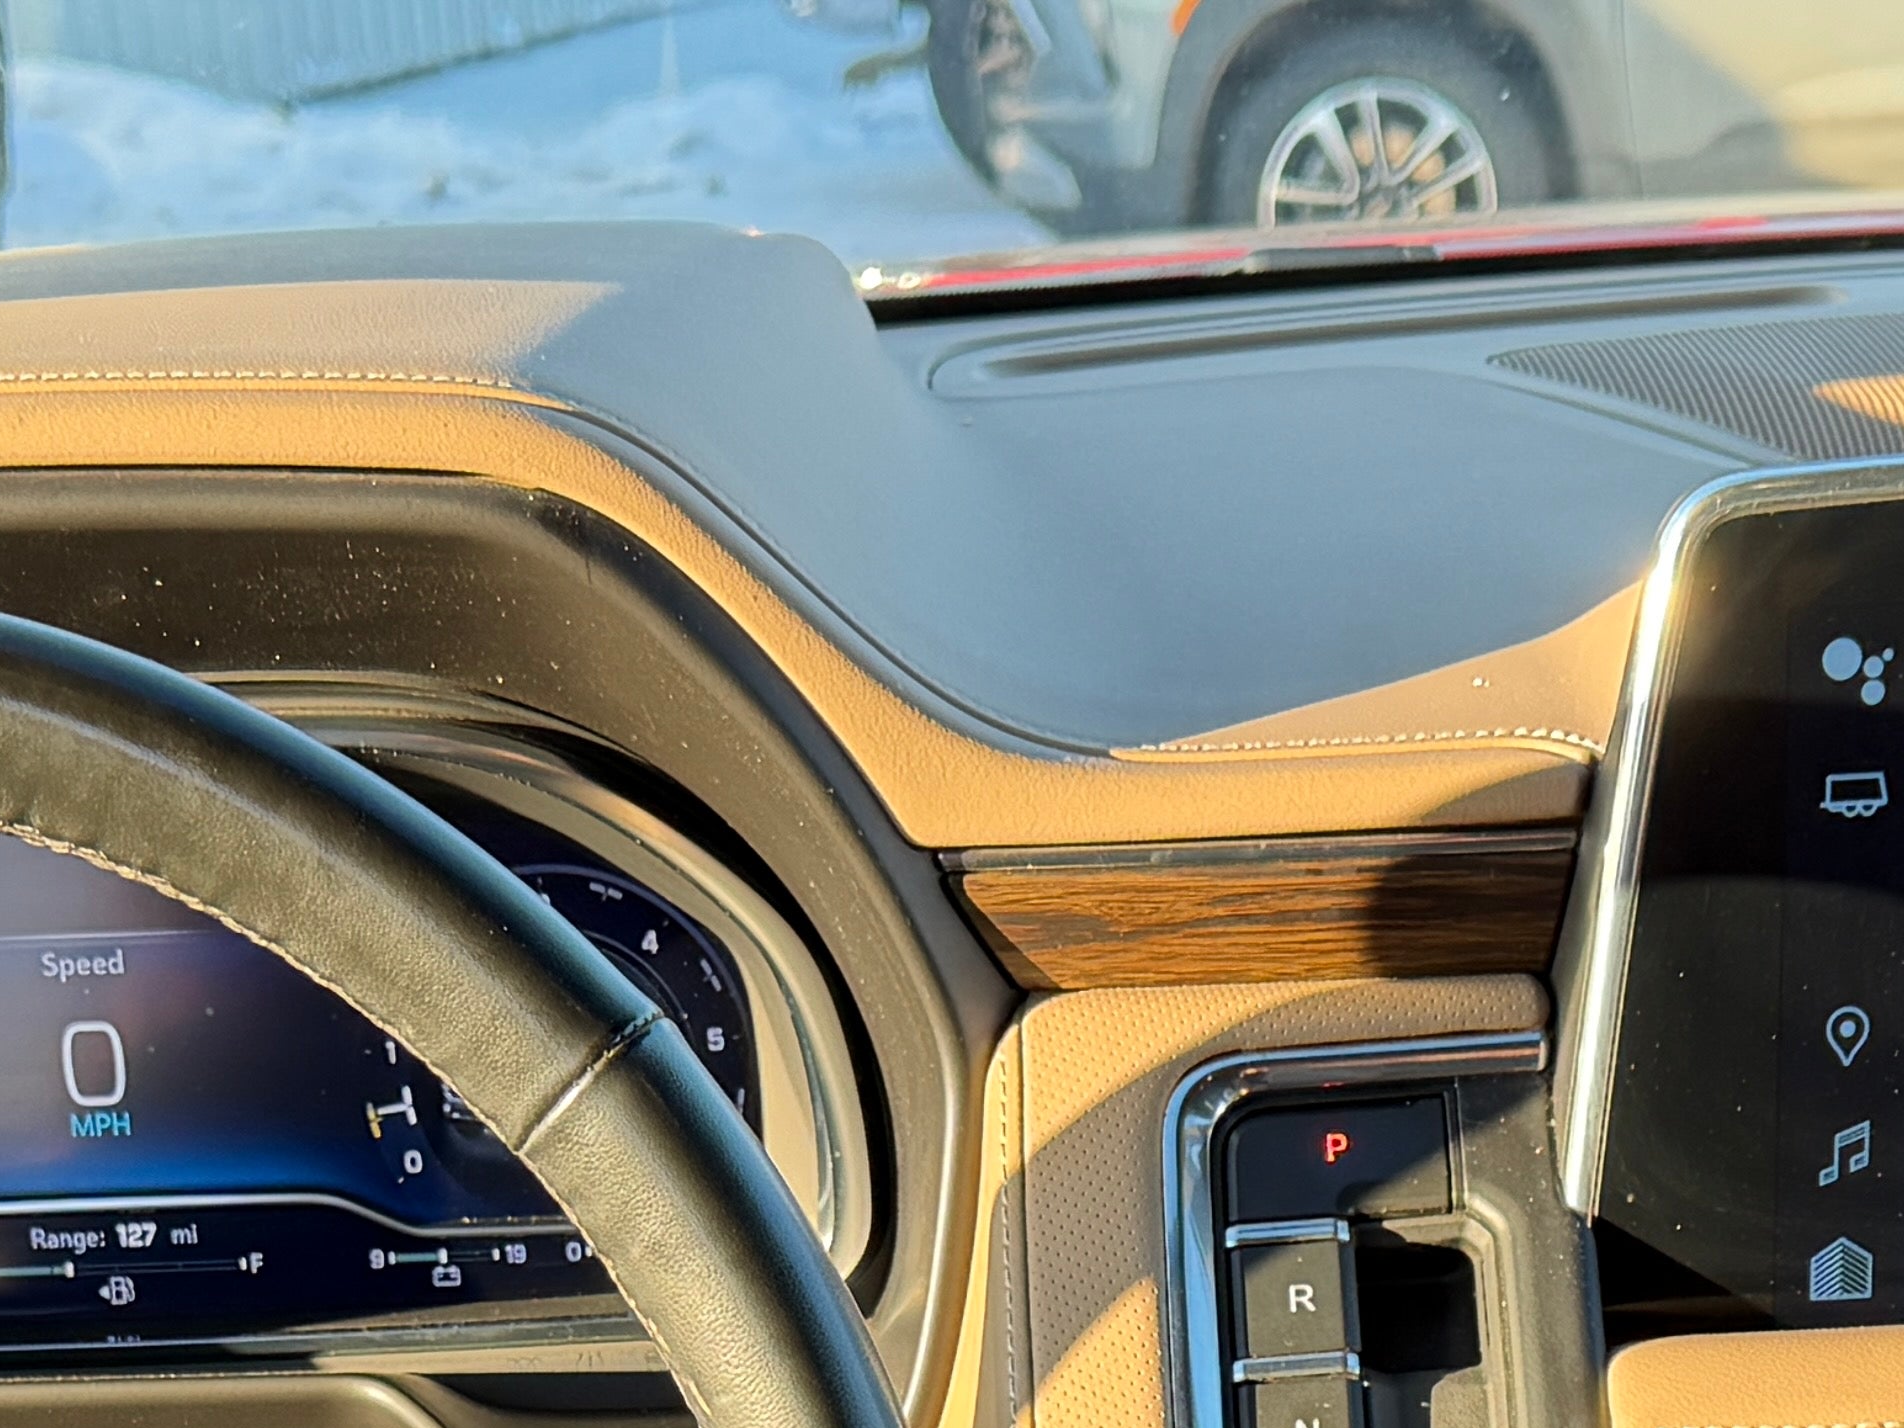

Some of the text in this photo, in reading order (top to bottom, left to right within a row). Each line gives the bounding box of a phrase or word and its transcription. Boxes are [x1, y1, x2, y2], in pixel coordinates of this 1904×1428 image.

[641, 928, 659, 955] 4
[40, 948, 126, 983] Speed
[706, 1026, 726, 1053] 5
[61, 1019, 127, 1108] 0
[69, 1110, 132, 1138] MPH
[1324, 1131, 1350, 1164] P
[29, 1222, 198, 1255] Range: 127 mi
[249, 1251, 263, 1275] F
[1288, 1283, 1317, 1313] R
